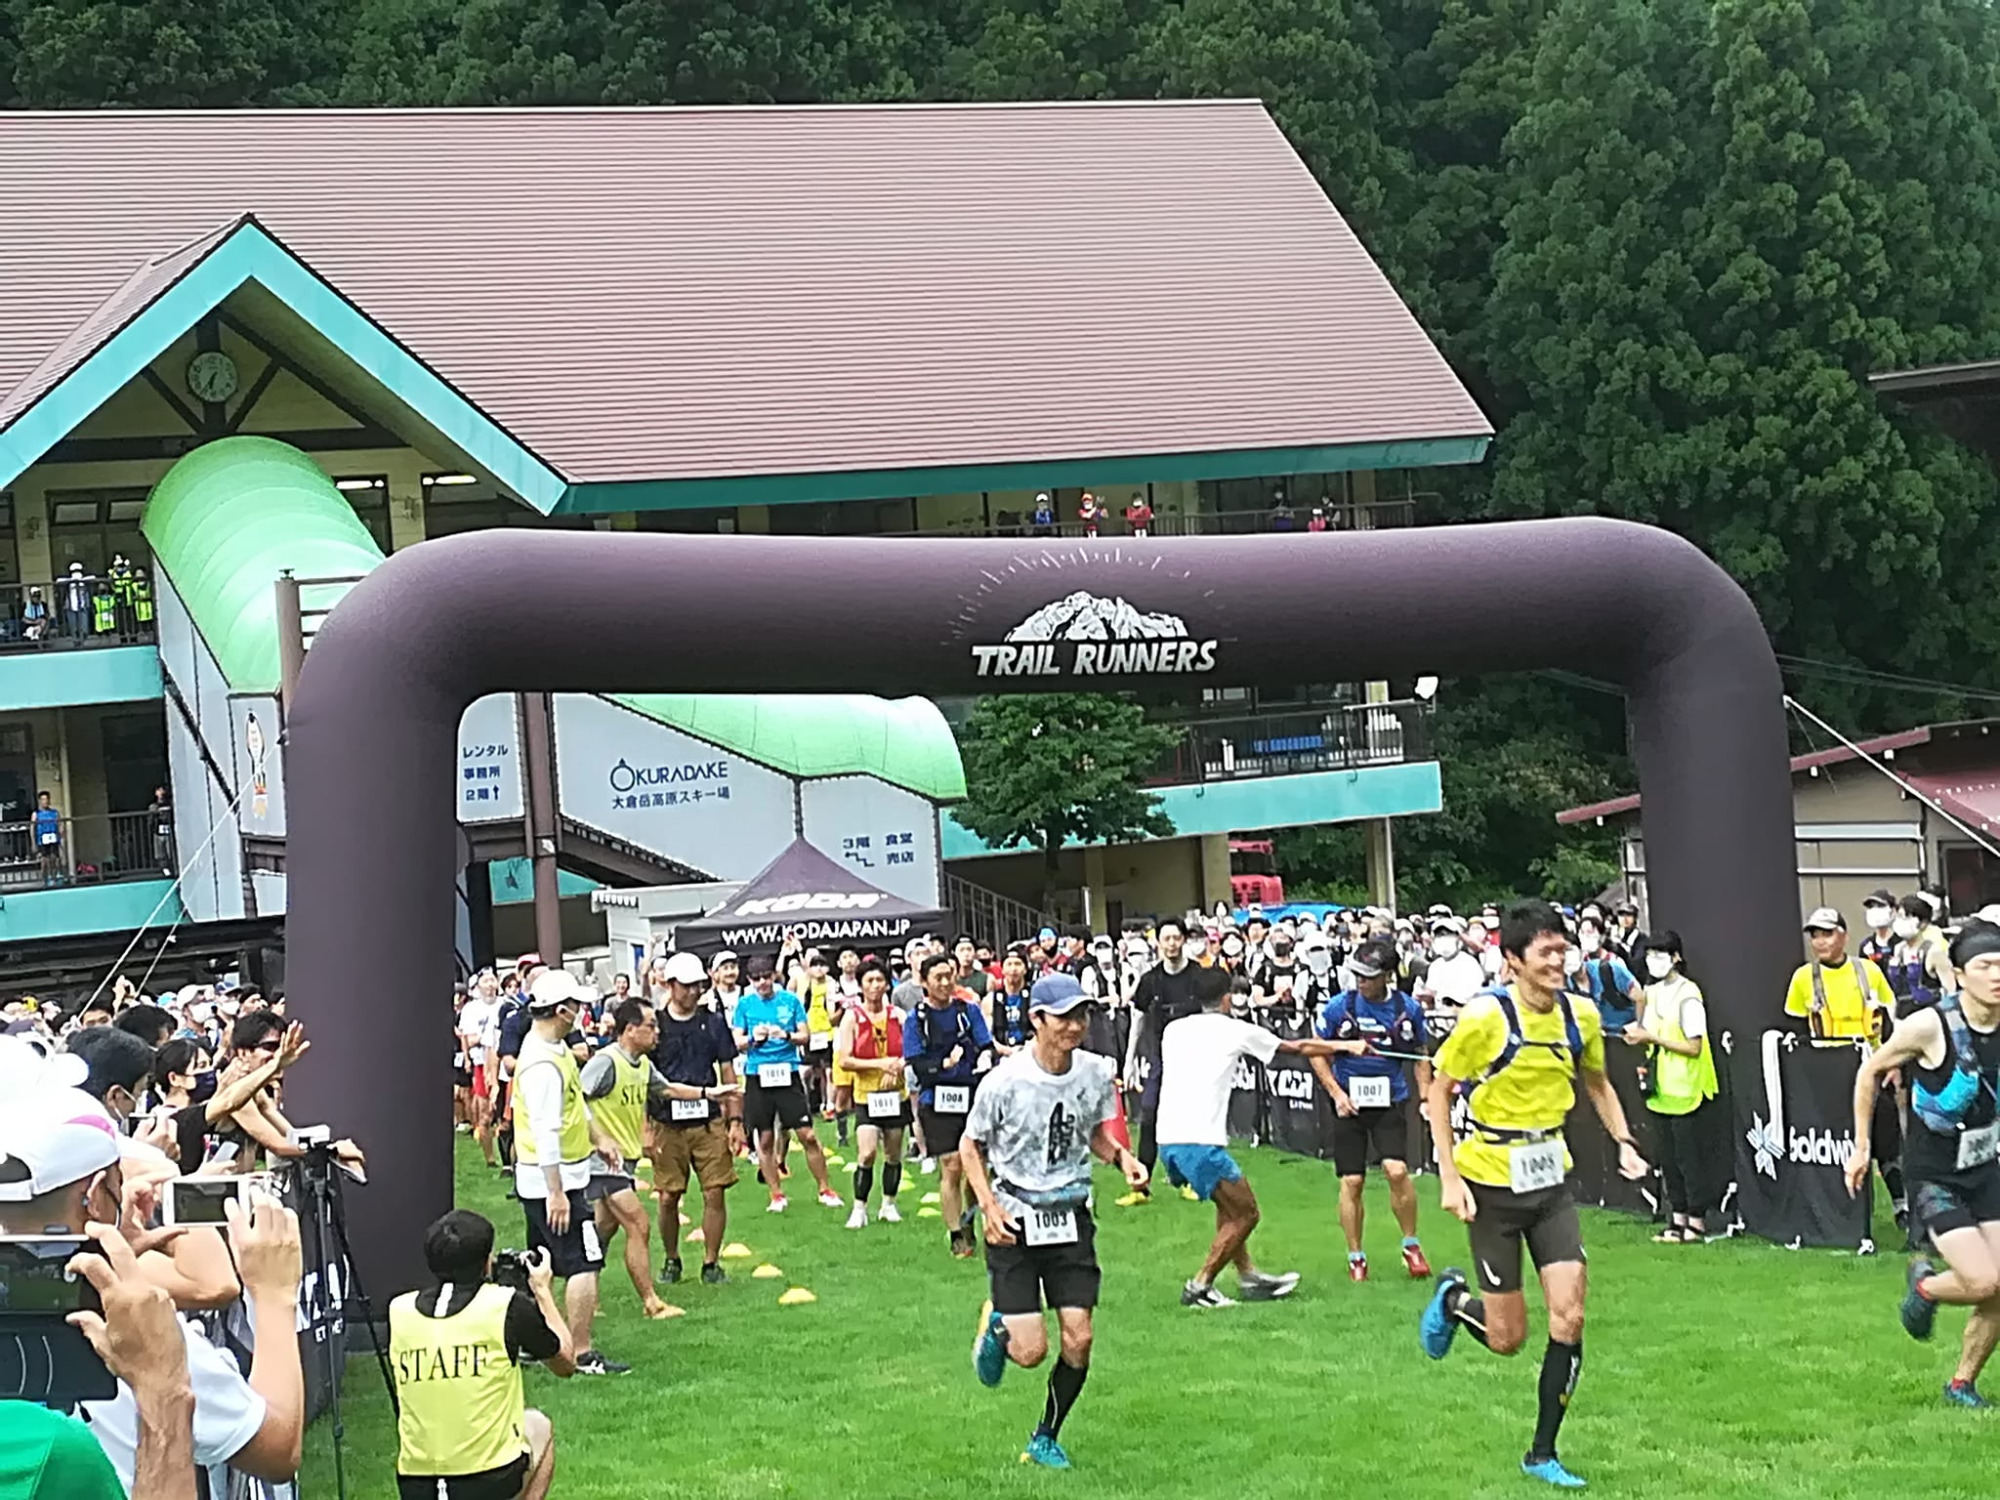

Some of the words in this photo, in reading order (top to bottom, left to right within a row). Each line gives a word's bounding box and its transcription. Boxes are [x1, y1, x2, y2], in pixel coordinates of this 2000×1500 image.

[971, 645, 1060, 676] TRAIL
[1073, 640, 1218, 675] RUNNERS
[462, 744, 508, 759] レンタル
[612, 786, 730, 810] 大倉岳高原スキー場
[1357, 1085, 1383, 1097] 1007
[1035, 1211, 1068, 1229] 1003
[400, 1344, 488, 1385] STAFF
